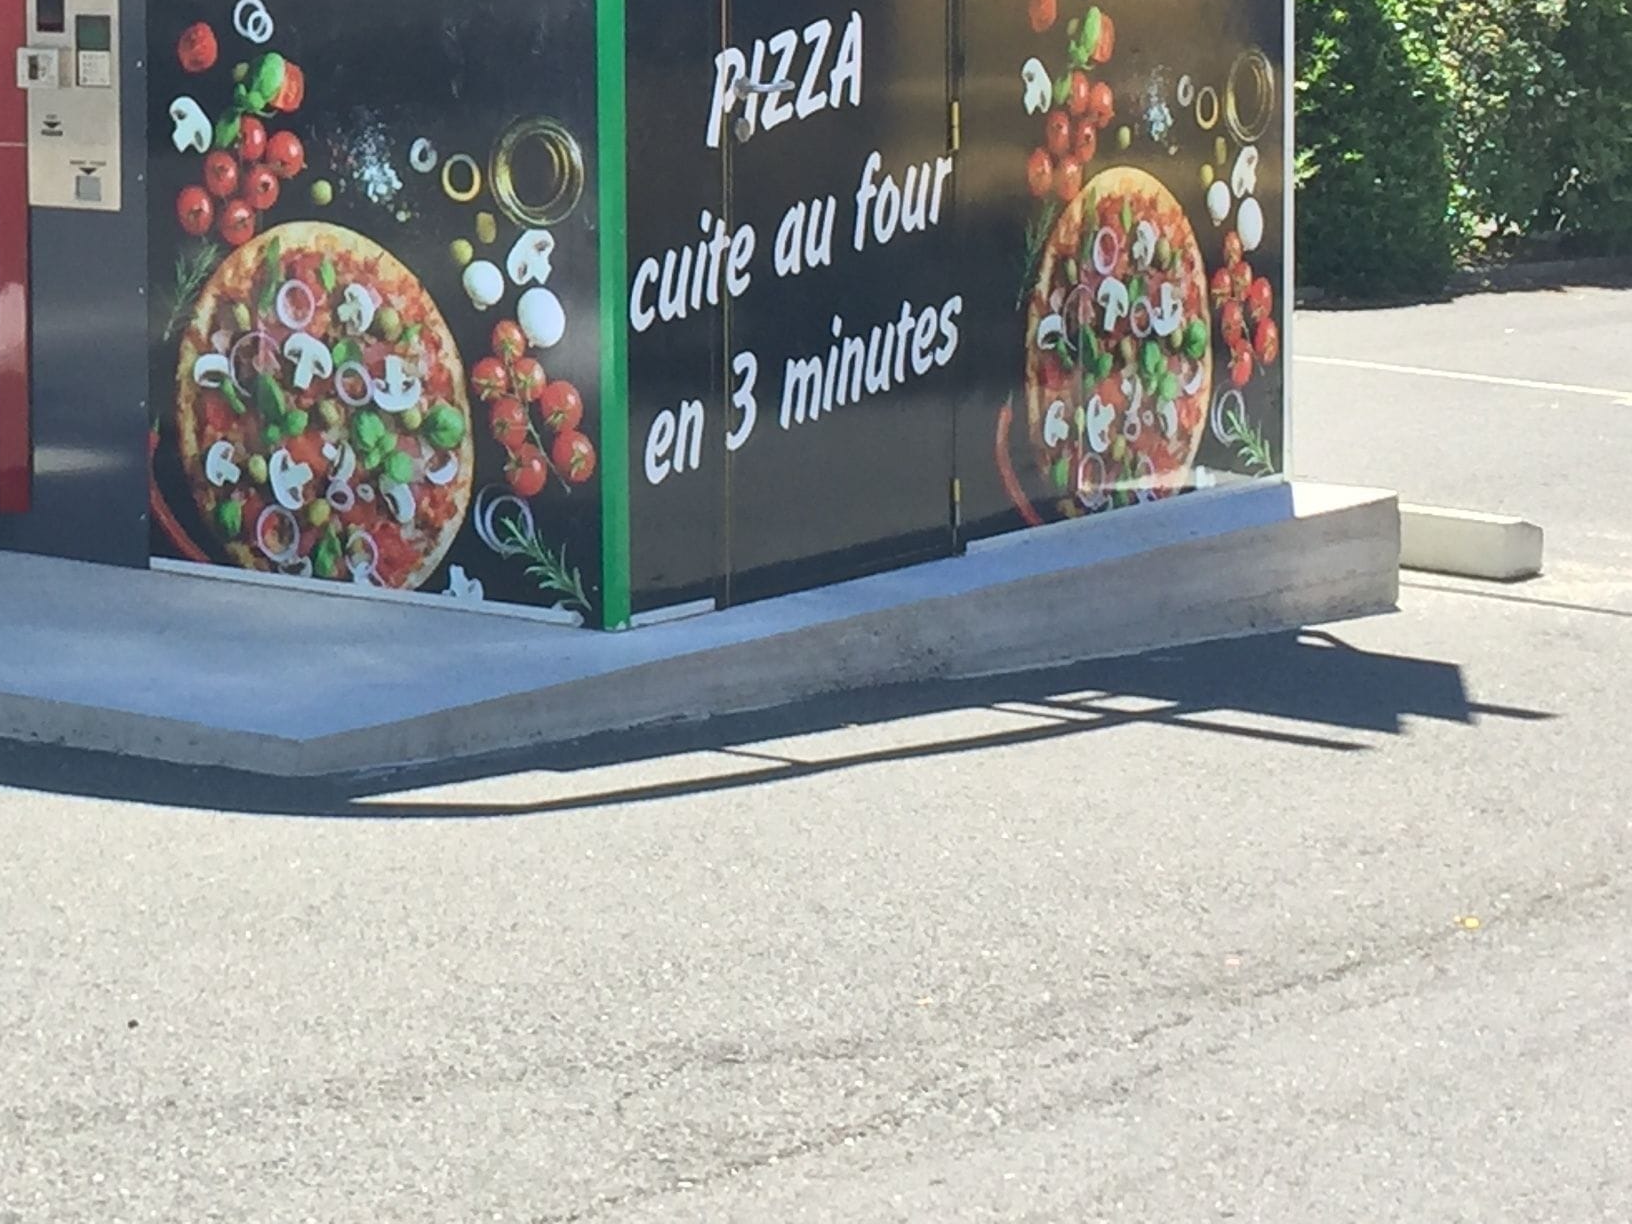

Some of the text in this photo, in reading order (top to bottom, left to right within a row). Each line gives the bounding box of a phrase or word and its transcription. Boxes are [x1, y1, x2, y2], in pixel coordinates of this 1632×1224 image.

[706, 10, 862, 148] PIZZA
[630, 150, 953, 332] cuite au four
[644, 294, 963, 485] en 3 minutes
